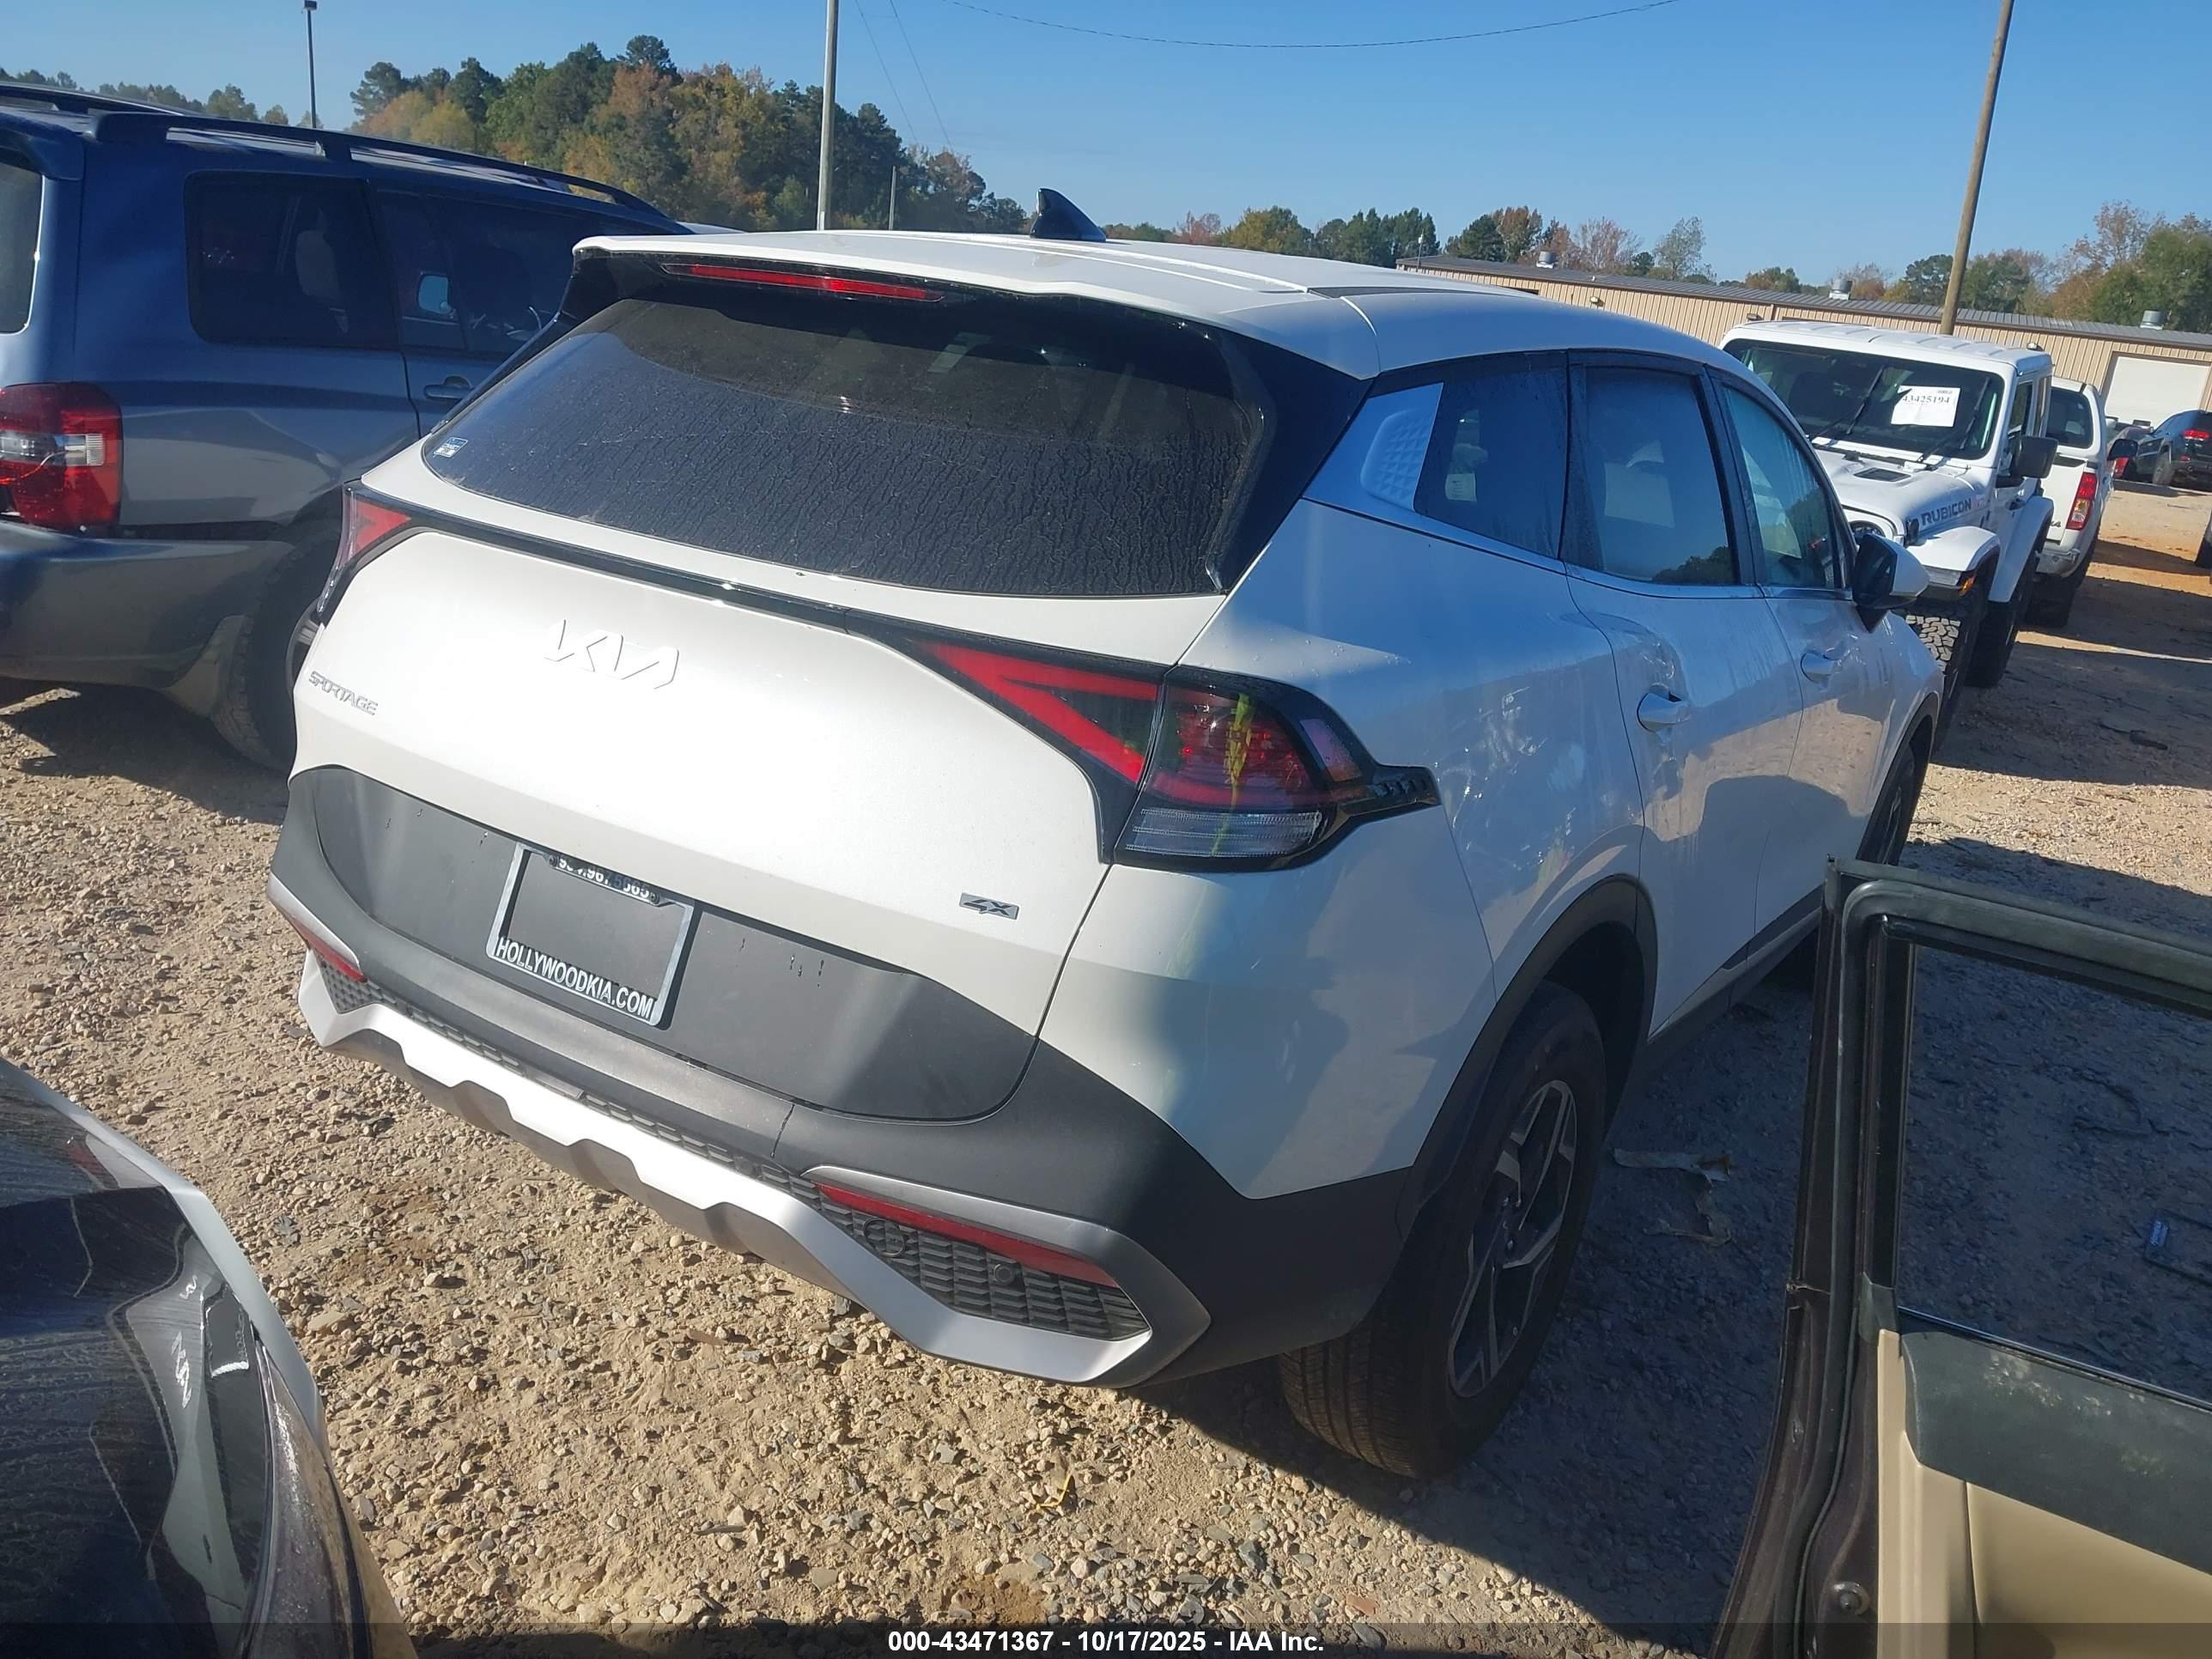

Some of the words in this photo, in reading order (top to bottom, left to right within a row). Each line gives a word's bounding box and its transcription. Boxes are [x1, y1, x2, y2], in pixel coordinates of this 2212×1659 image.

[1920, 497, 1972, 526] RUBICON
[542, 618, 680, 690] KIA
[308, 670, 379, 716] SPORTAGE
[495, 937, 655, 1019] HOLLYWOODKIA.COM
